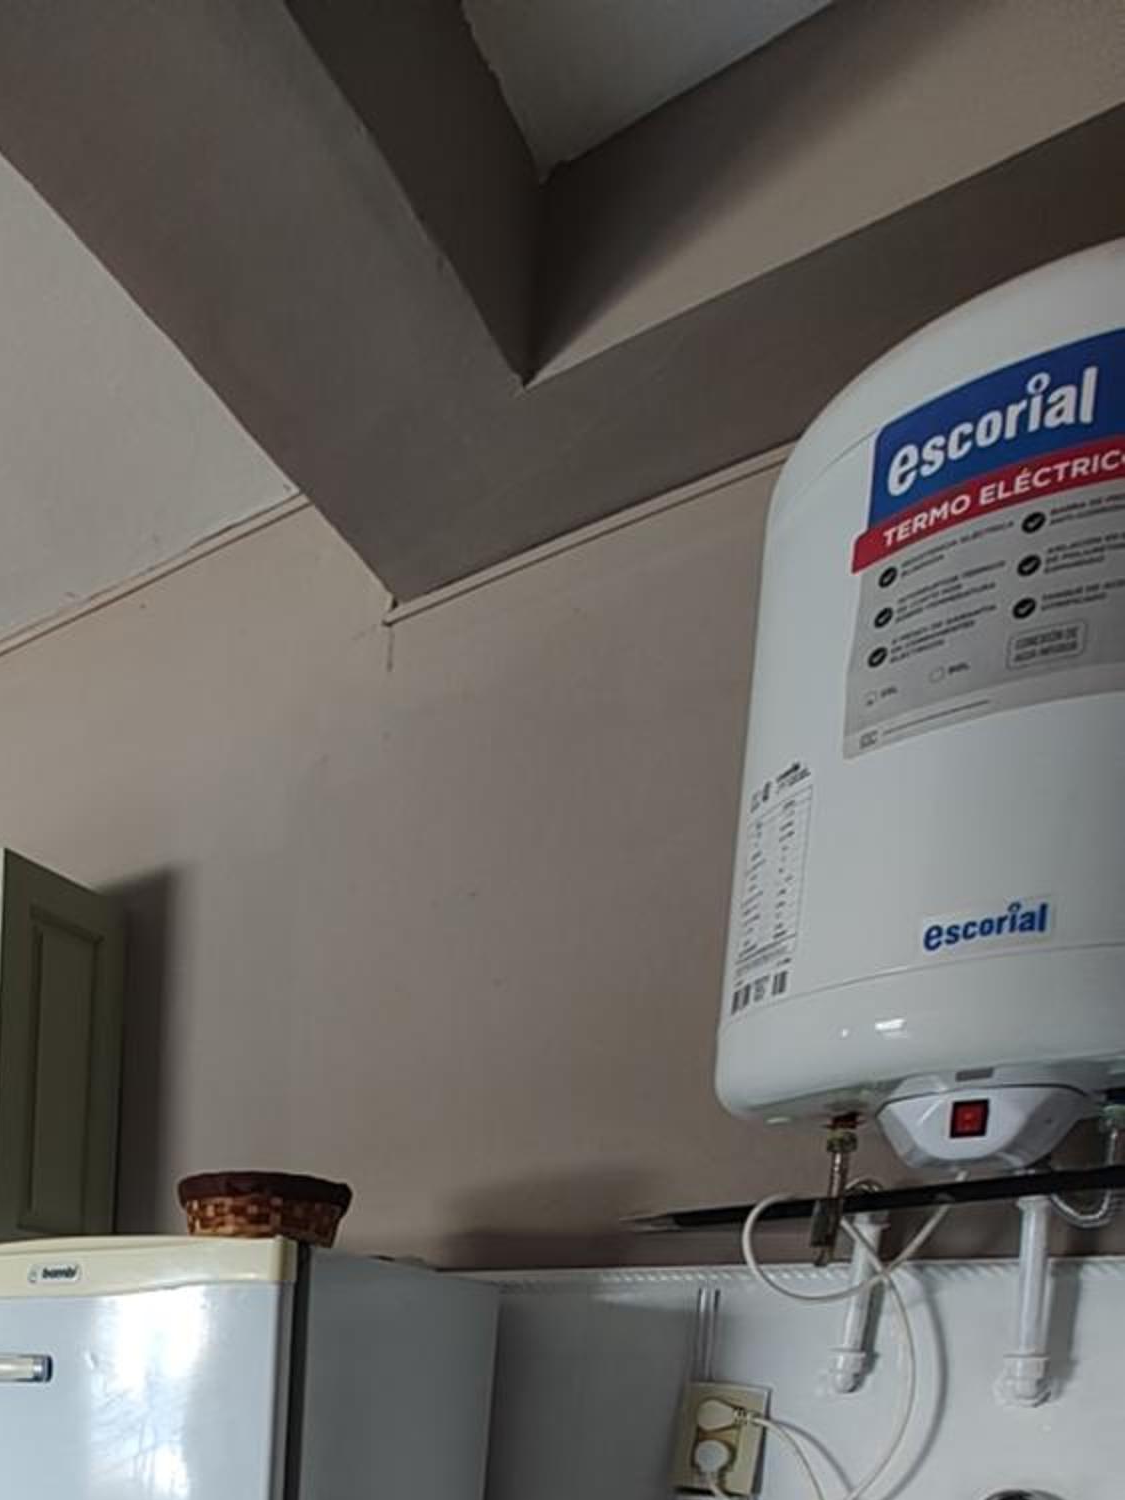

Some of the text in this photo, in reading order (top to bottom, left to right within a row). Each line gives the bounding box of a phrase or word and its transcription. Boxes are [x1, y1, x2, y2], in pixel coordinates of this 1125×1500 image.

[887, 365, 1099, 496] escorial
[882, 449, 1125, 547] TERMO ELÉCTRIC
[923, 901, 1048, 951] escorial
